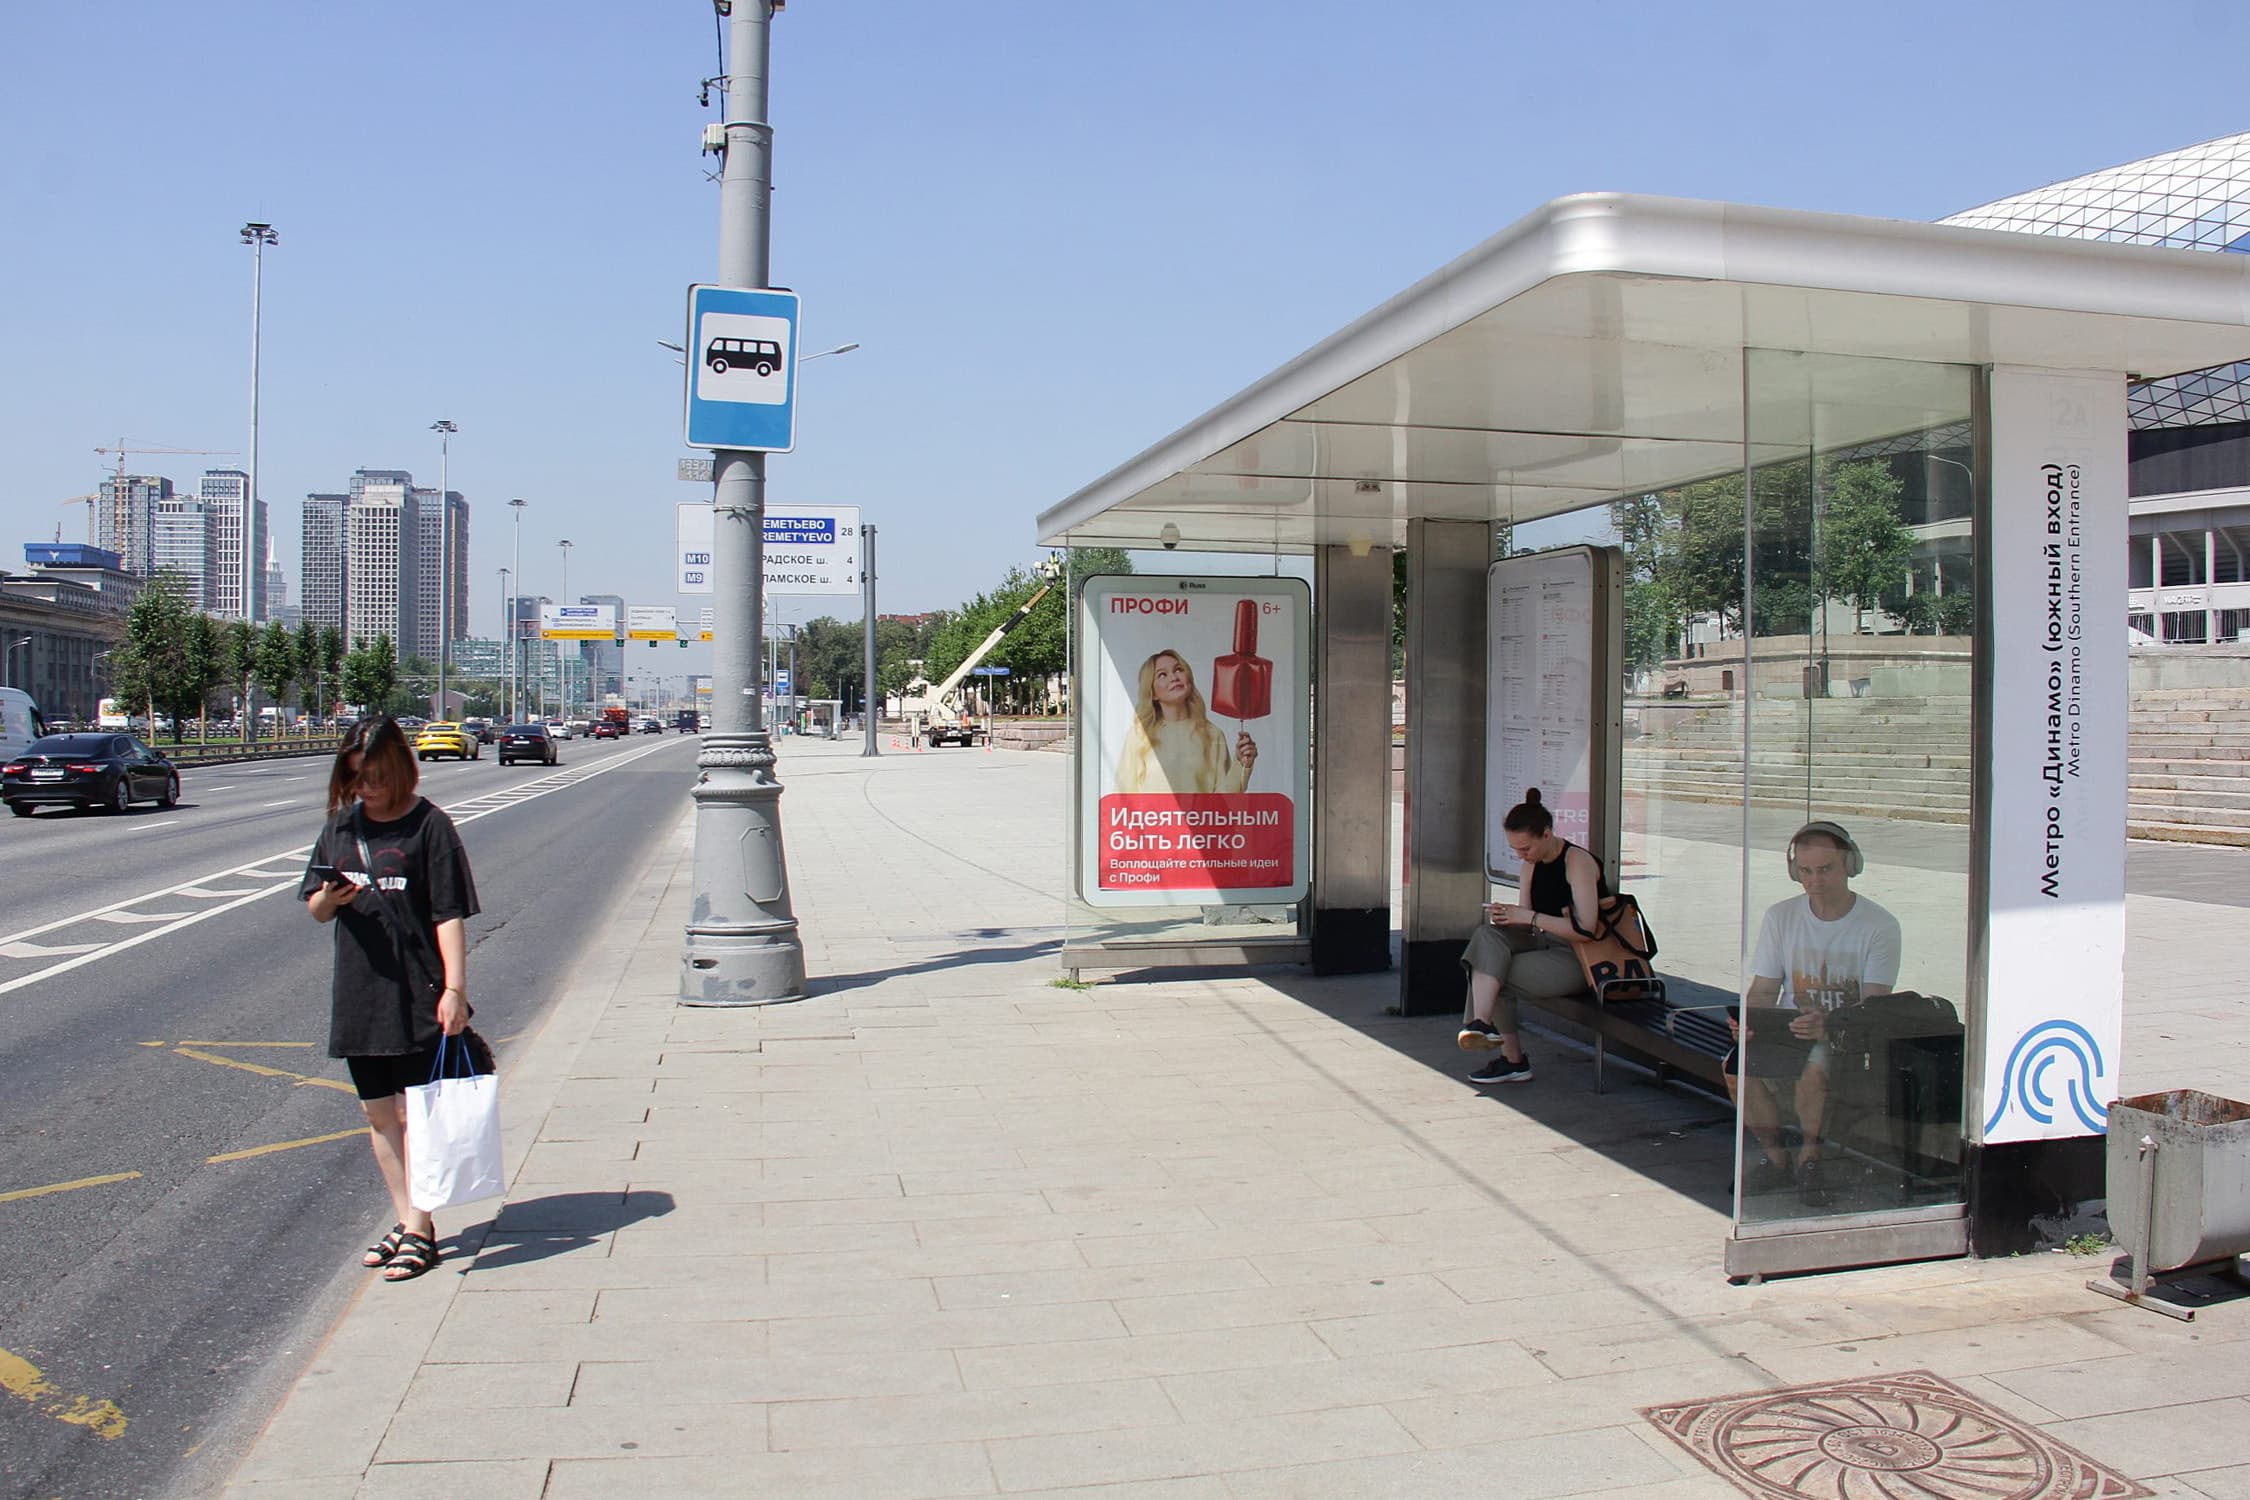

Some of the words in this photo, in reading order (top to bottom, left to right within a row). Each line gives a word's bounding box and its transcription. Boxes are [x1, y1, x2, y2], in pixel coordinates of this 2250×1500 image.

[2041, 464, 2064, 534] вход)
[2066, 464, 2081, 547] Entrance)
[763, 520, 826, 530] ЕМЕТЬЕВО
[841, 527, 854, 537] 28
[763, 532, 833, 542] REMET'YEVO
[762, 555, 813, 565] РАДСКОЕ
[846, 556, 853, 564] 4
[763, 574, 816, 584] ЛАМСКОЕ
[846, 575, 853, 583] 4
[1111, 597, 1189, 615] ПРОФИ
[2042, 544, 2063, 651] (южный
[2067, 553, 2082, 641] (Southern
[1262, 602, 1281, 614] 6+
[2068, 646, 2081, 716] Dinamo
[2043, 661, 2064, 798] «Динамо»
[2068, 722, 2080, 777] Metro
[1111, 807, 1279, 829] Идеятельным
[1110, 831, 1171, 850] быть
[1177, 834, 1246, 850] легко
[2041, 806, 2064, 898] Метро
[1110, 858, 1187, 870] Воплощайте
[1189, 859, 1248, 869] стильные
[1249, 859, 1279, 869] идеи
[1109, 874, 1117, 882] с
[1119, 872, 1160, 884] Профи
